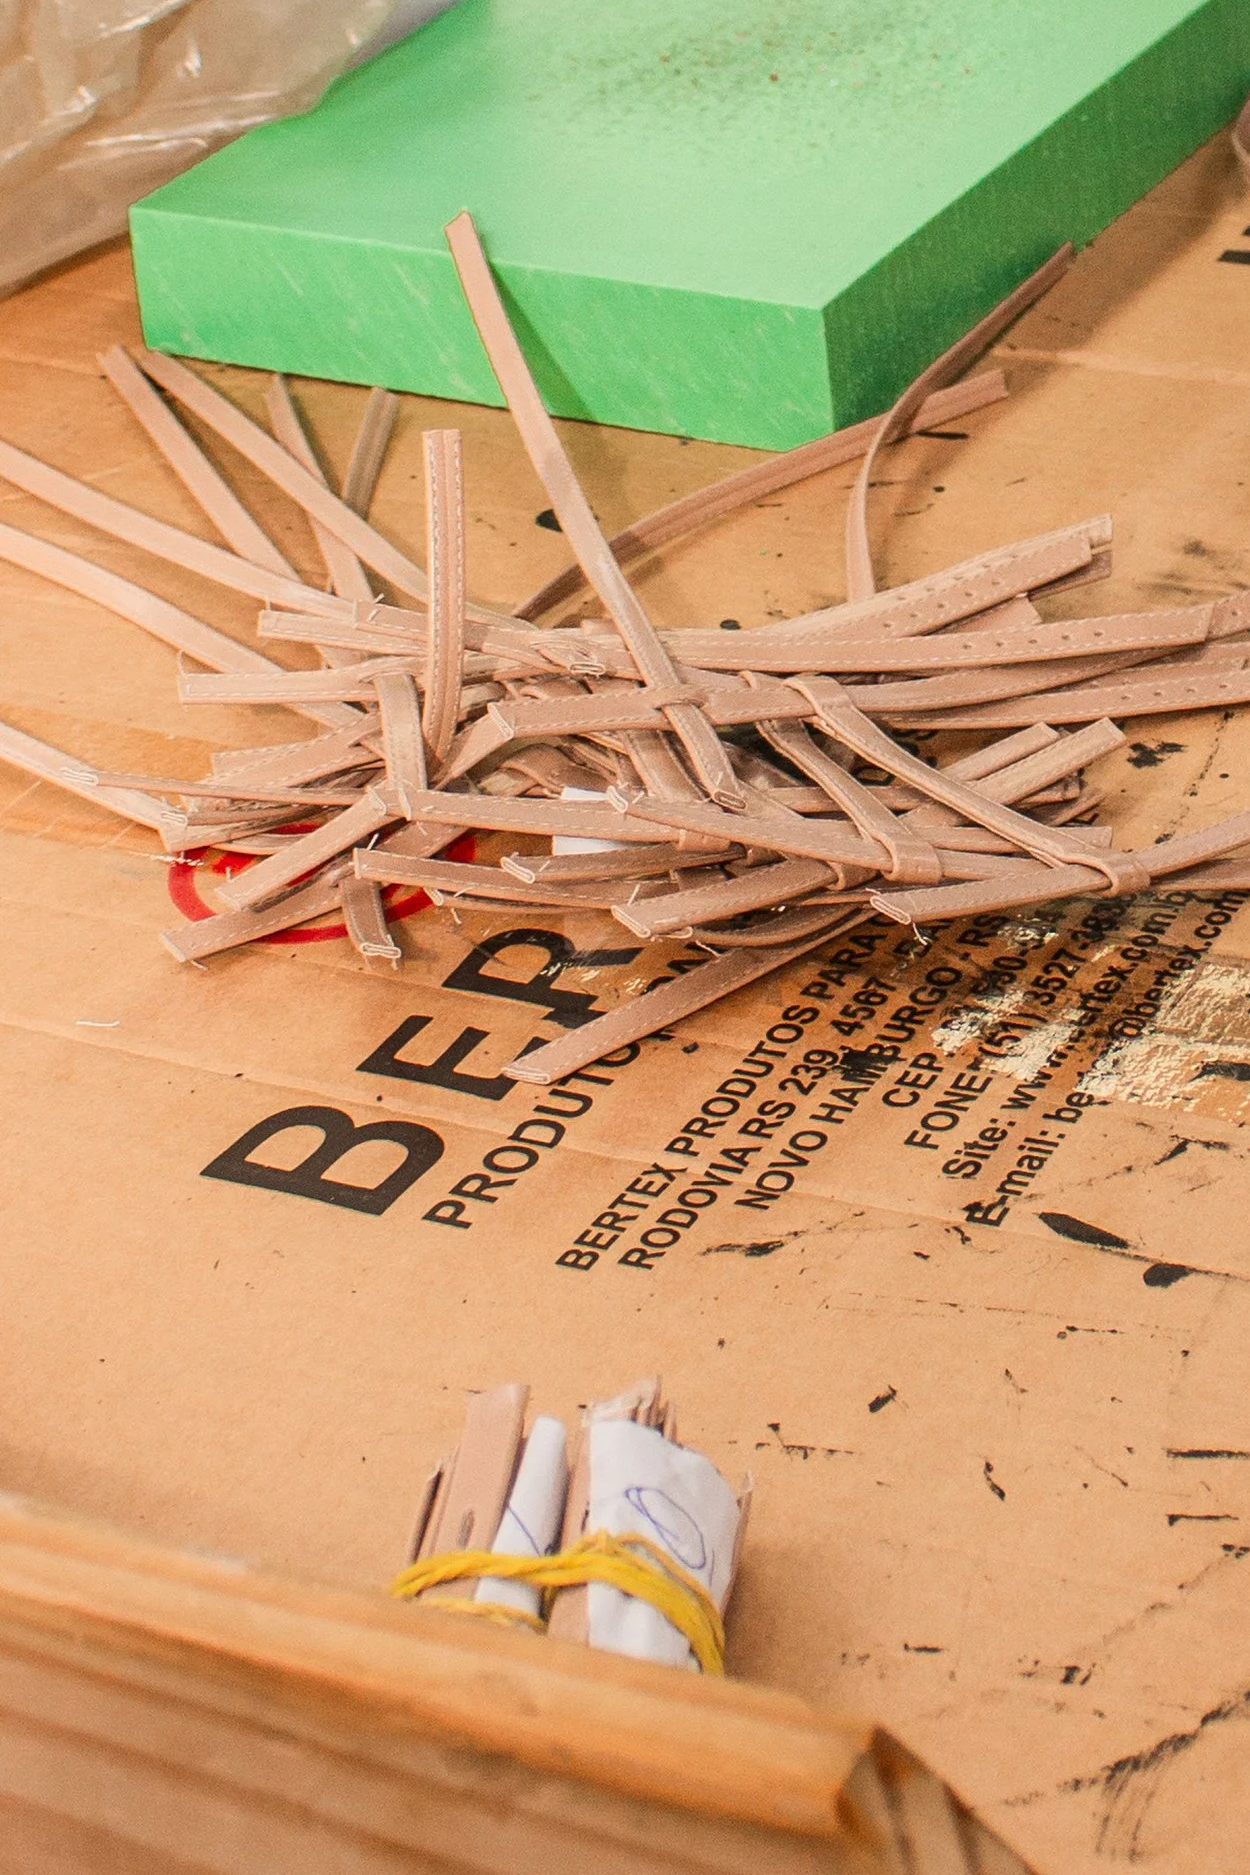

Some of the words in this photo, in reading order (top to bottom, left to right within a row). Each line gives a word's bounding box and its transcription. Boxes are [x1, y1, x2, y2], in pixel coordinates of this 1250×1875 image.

[200, 928, 644, 1218] BER
[422, 1037, 641, 1230] PRODUTO
[555, 1162, 690, 1272] BERTEX
[672, 1000, 819, 1158] PRODUTOS
[811, 929, 887, 1005] PARA
[617, 1137, 753, 1271] RODOVIA
[740, 1090, 797, 1145] RS
[838, 975, 897, 1039] 4567
[733, 1128, 832, 1212] NOVO
[809, 965, 963, 1132] HAMBURGO
[956, 915, 1010, 947] RS
[942, 1117, 1017, 1180] Site:
[965, 1130, 1067, 1227] E-mail:
